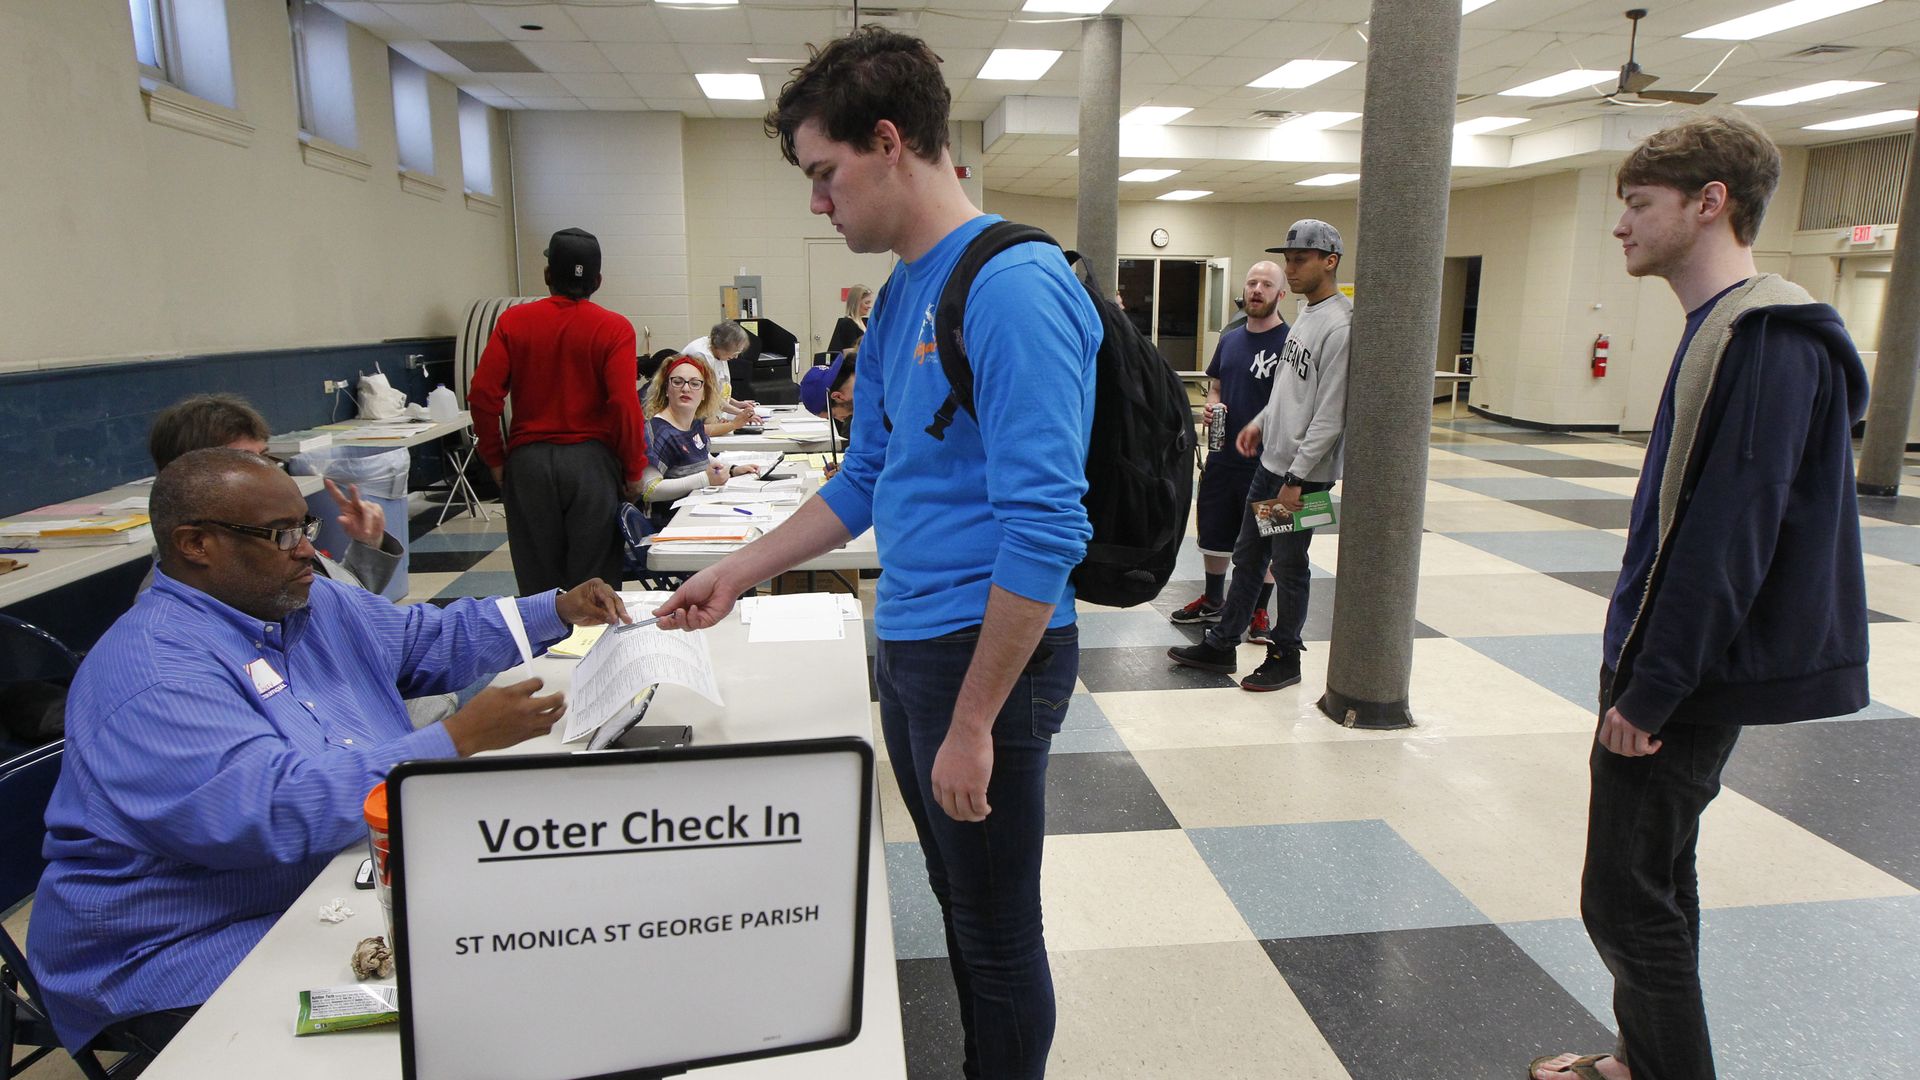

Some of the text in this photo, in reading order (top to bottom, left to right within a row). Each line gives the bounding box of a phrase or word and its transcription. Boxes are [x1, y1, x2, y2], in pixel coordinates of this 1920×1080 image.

[1853, 226, 1872, 242] EXIT
[477, 804, 800, 854] Voter Check In
[455, 904, 819, 956] ST MONICA ST GEORGE PARISH
